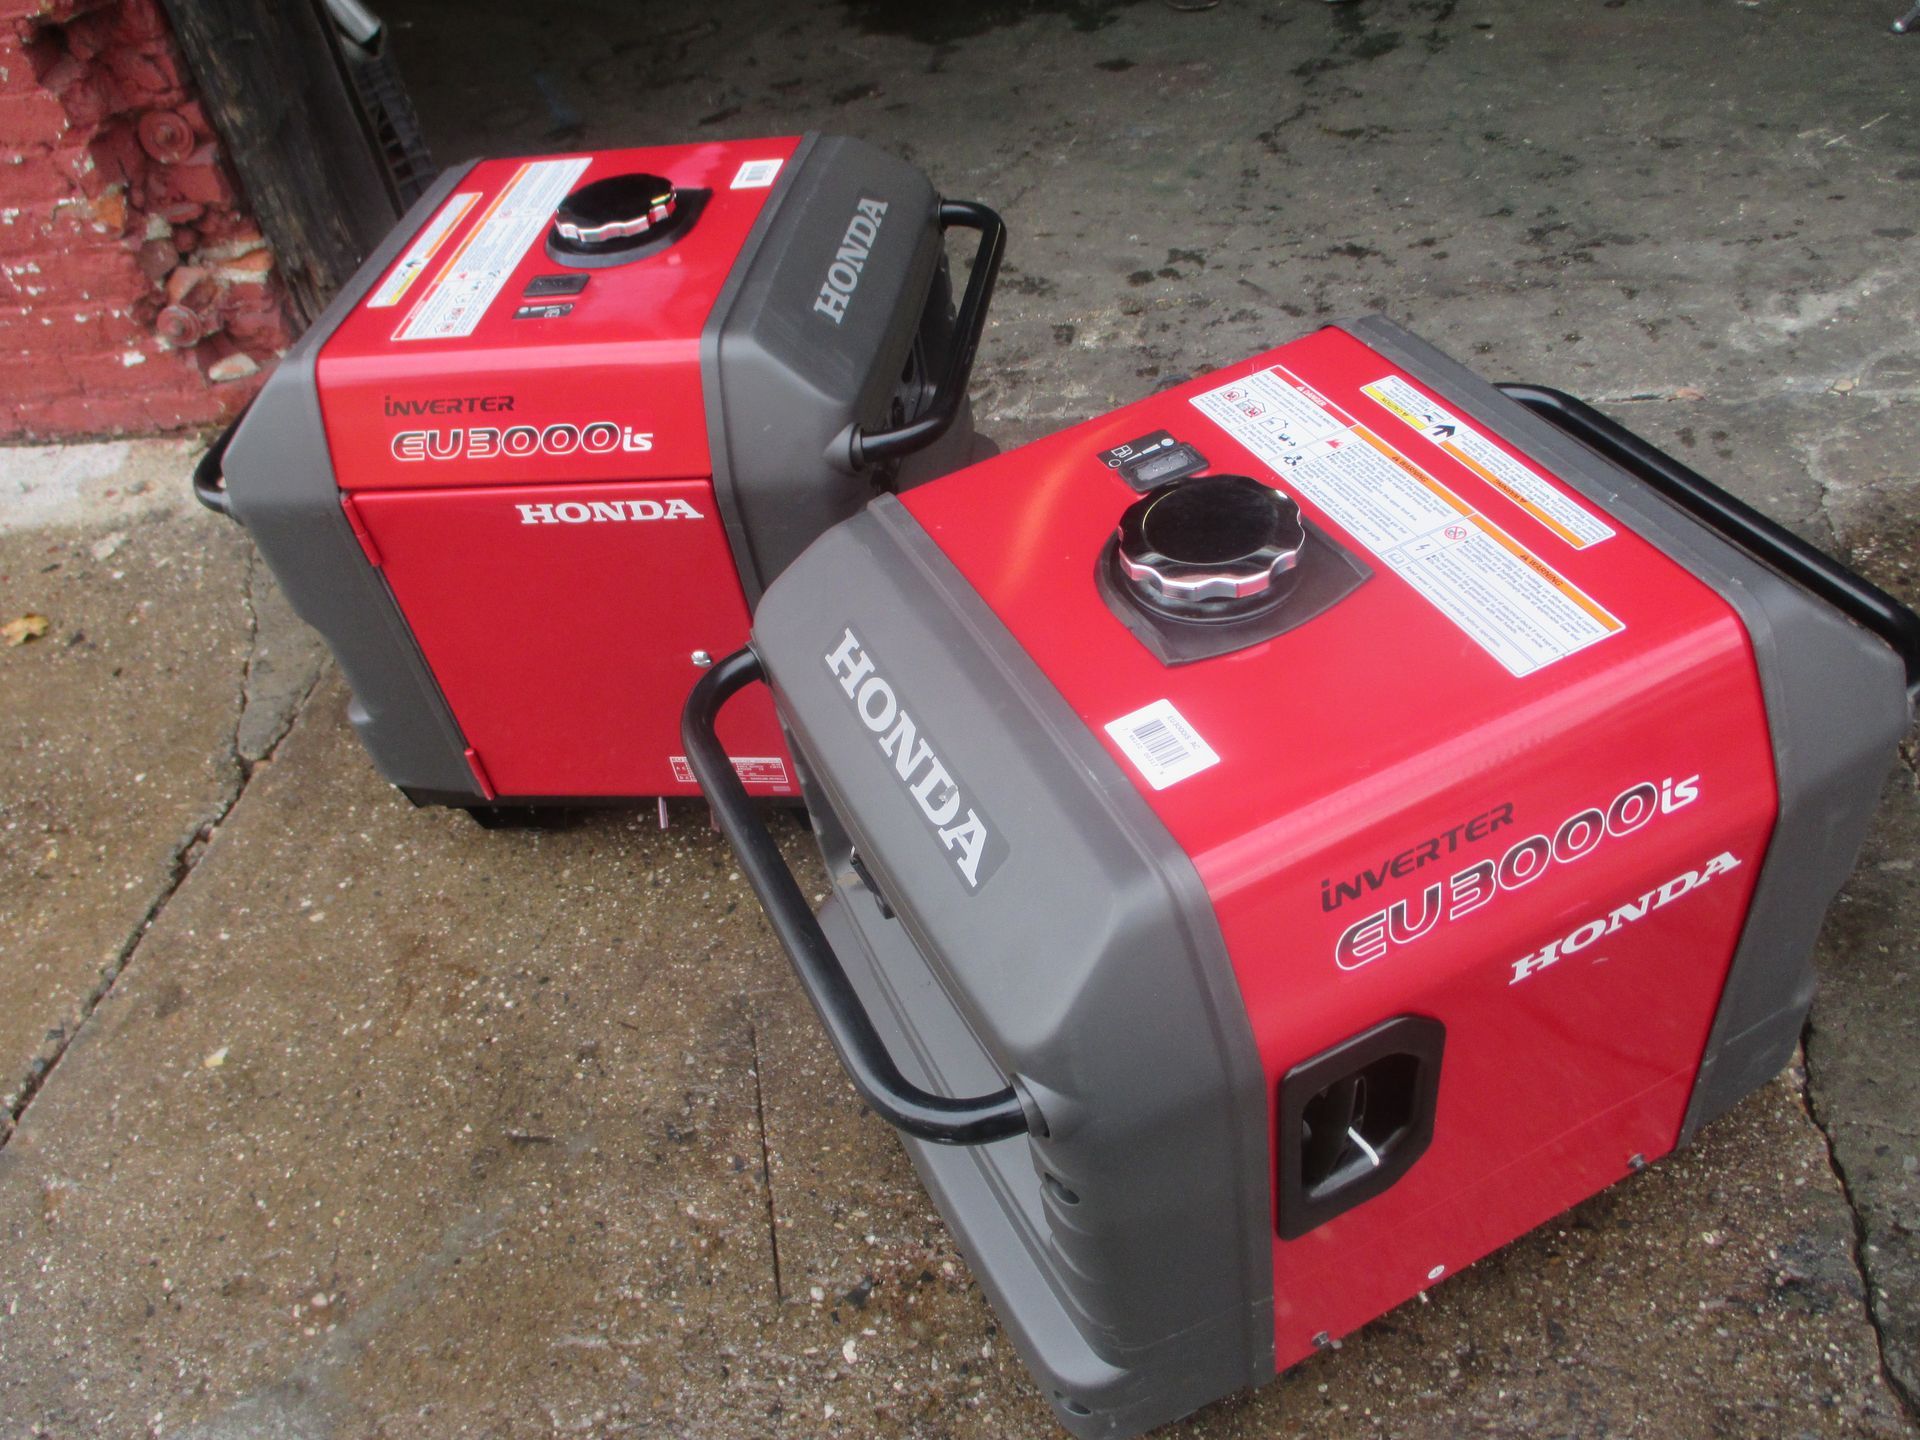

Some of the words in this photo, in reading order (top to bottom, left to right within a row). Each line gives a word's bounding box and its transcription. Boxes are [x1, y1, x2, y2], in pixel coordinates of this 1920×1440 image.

[813, 199, 889, 325] HONDA
[515, 498, 705, 525] HONDA
[1529, 560, 1563, 586] WARNING
[825, 627, 987, 888] HONDA
[1509, 850, 1742, 985] HONDA
